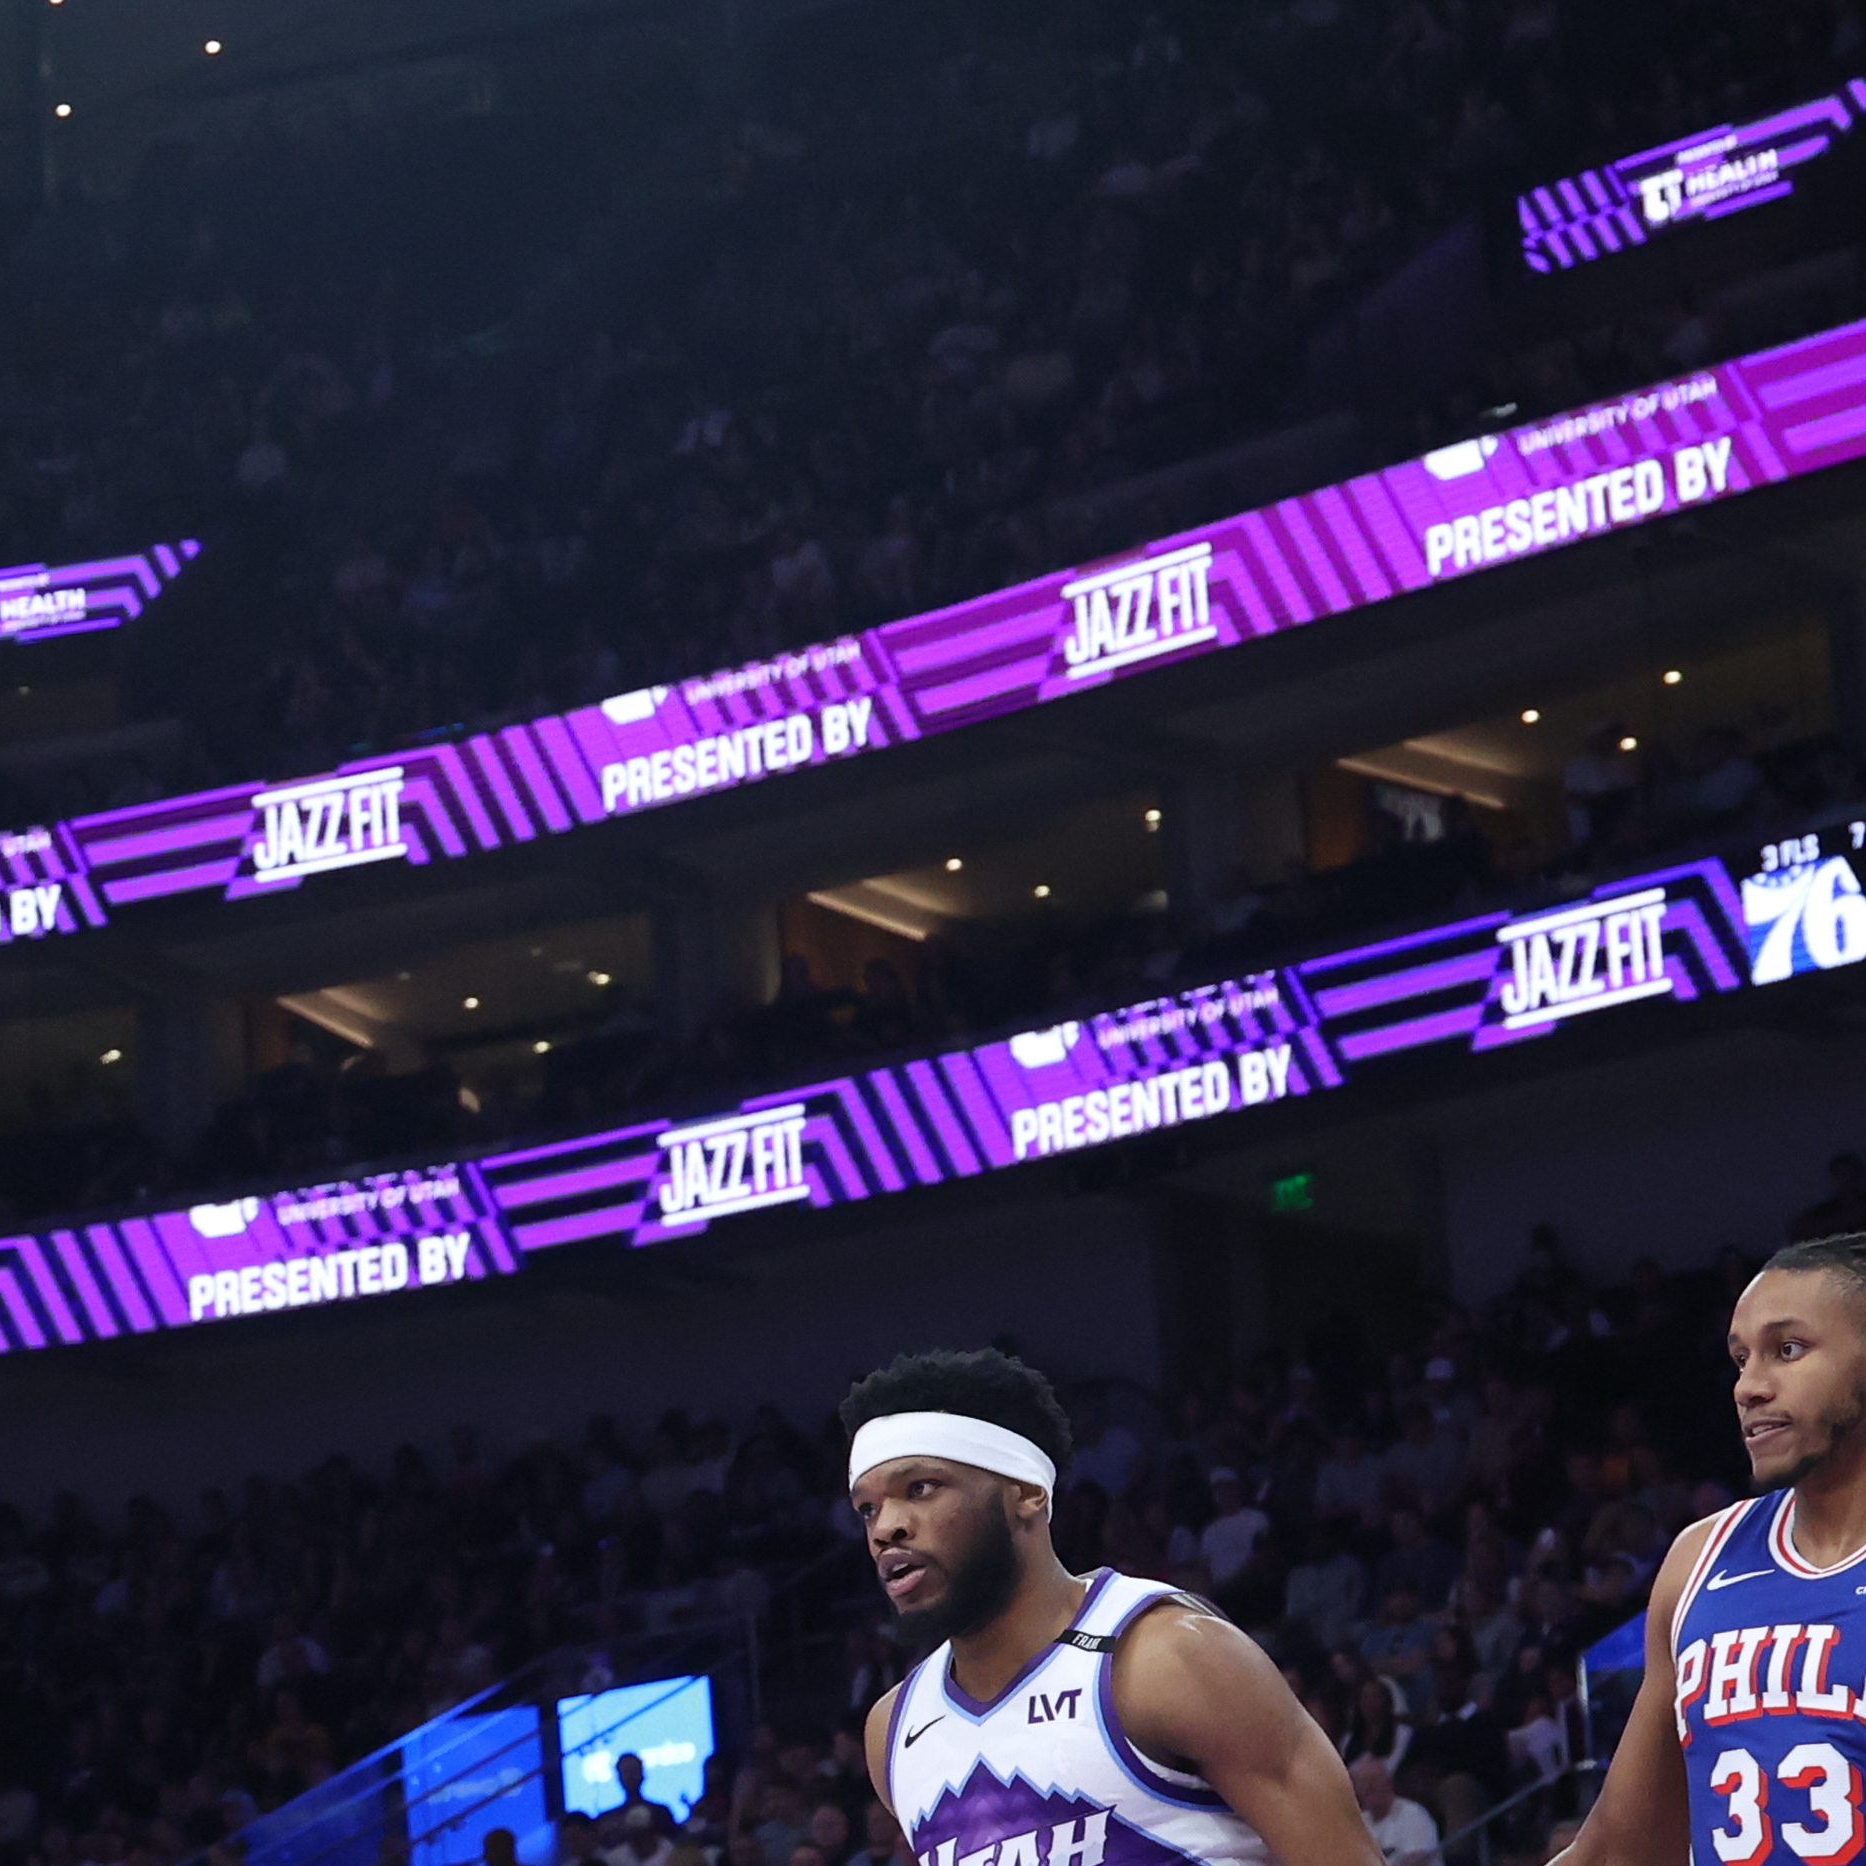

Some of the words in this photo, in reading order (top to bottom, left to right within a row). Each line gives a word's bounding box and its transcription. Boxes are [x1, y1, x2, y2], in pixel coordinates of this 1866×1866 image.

[1518, 401, 1630, 455] UNIVERSITY
[1630, 392, 1665, 420] OF
[1664, 375, 1718, 410] UTAH
[1424, 458, 1664, 576] PRESENTED
[1673, 436, 1732, 504] BY
[0, 587, 87, 620] HEALTH
[1064, 572, 1158, 665] JAZZ
[1158, 556, 1212, 637] FIT
[600, 718, 814, 813] PRESENTED
[820, 695, 872, 757] BY
[253, 790, 348, 872] JAZZ
[348, 780, 405, 848] FIT
[1760, 844, 1779, 873] 3
[10, 883, 63, 936] BY
[1741, 854, 1866, 987] 76
[1500, 920, 1604, 1016] JAZZ
[1604, 902, 1666, 990] FIT
[1012, 1064, 1231, 1161] PRESENTED
[1238, 1045, 1291, 1107] BY
[659, 1132, 752, 1214] JAZZ
[752, 1118, 807, 1194] FIT
[188, 1243, 410, 1321] PRESENTED
[418, 1232, 471, 1284] BY
[1028, 1687, 1083, 1725] LVT
[1674, 1624, 1866, 1748] PHIL
